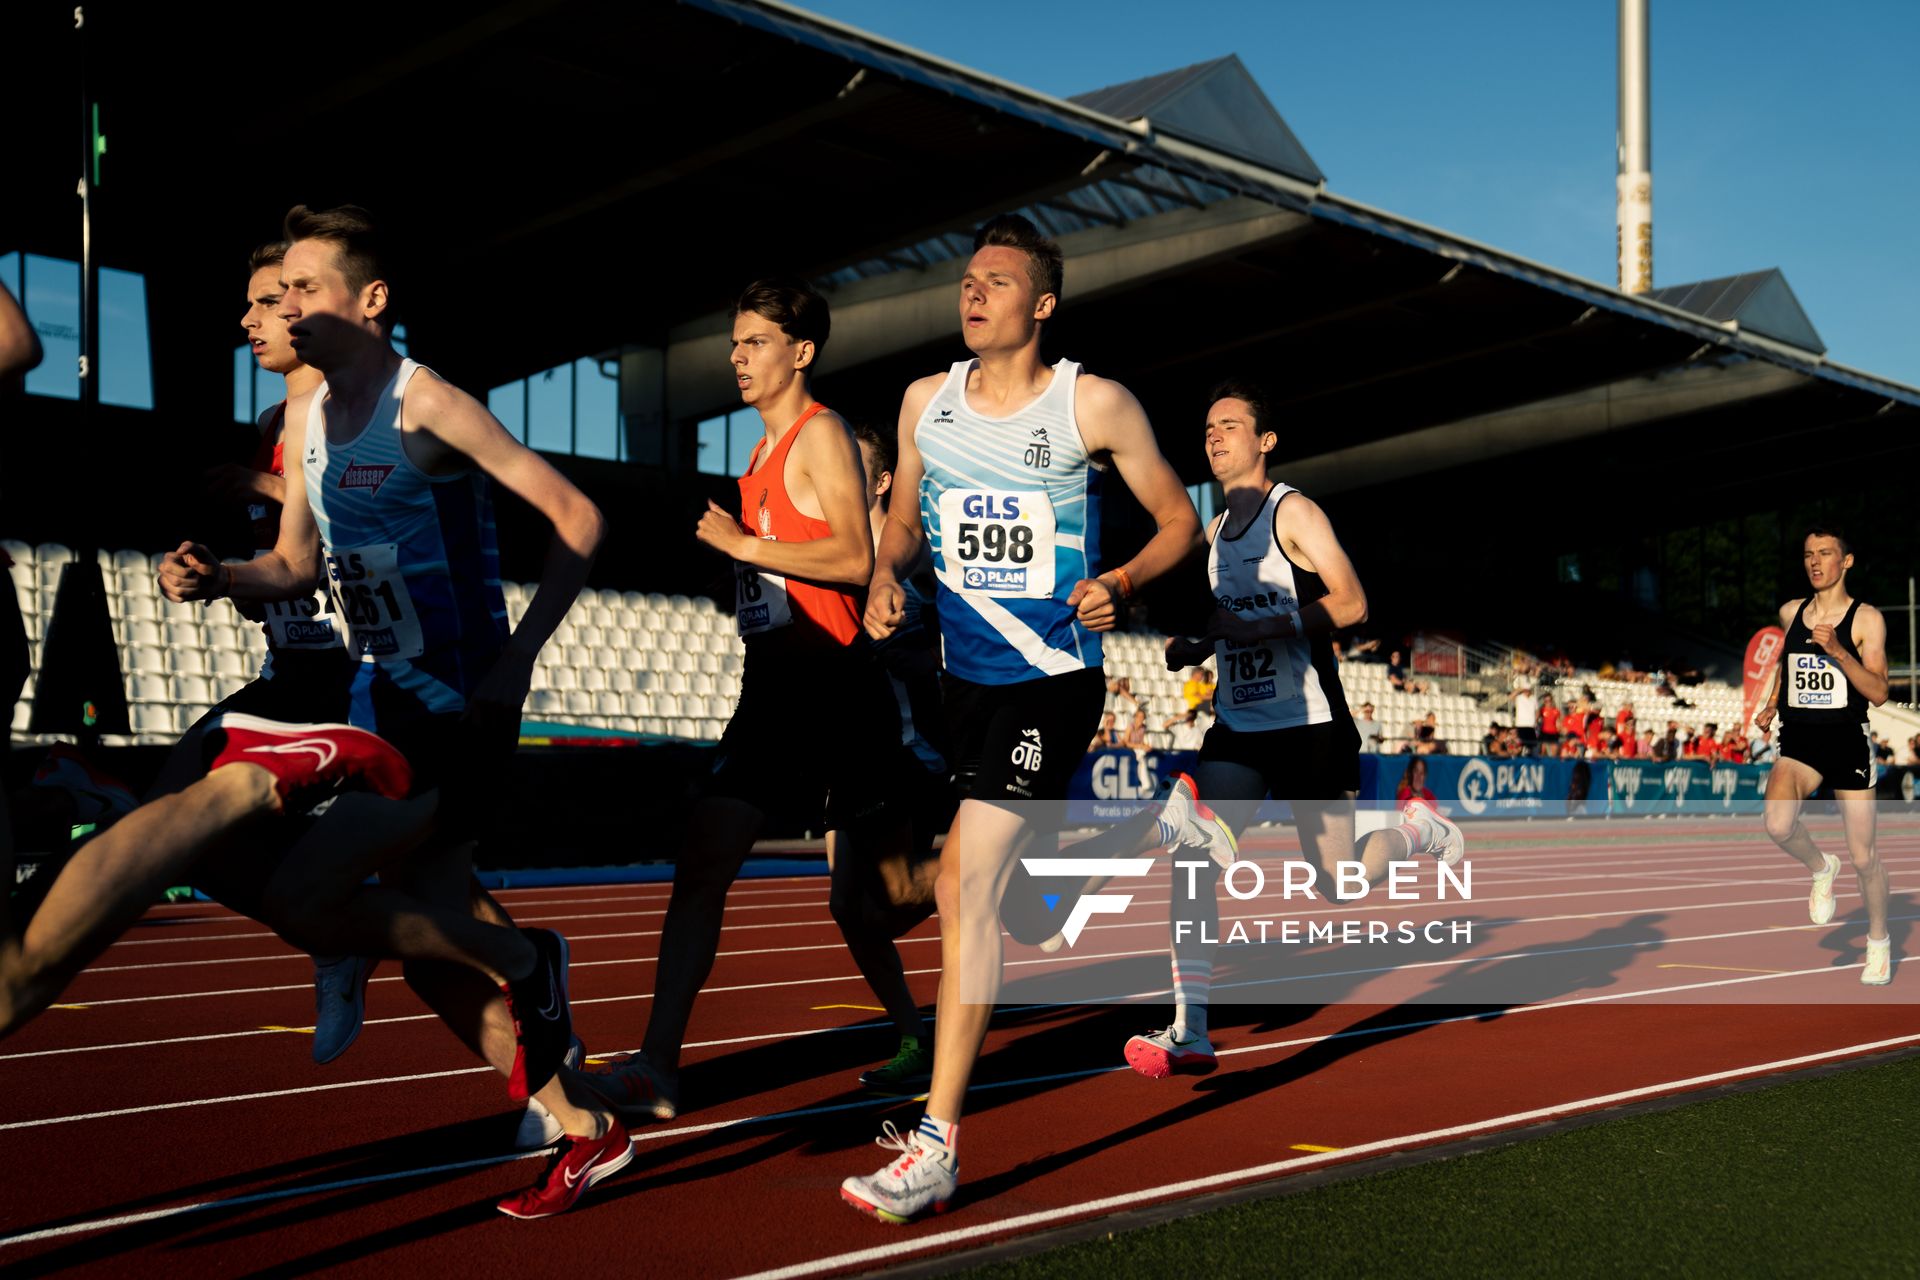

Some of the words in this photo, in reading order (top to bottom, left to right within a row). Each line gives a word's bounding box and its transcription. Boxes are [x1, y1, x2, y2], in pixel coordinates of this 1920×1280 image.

[74, 6, 84, 29] 5
[79, 355, 89, 378] 3
[1024, 443, 1051, 468] OTB
[963, 494, 1020, 520] GLS
[957, 523, 1034, 563] 598
[327, 554, 365, 581] GLS
[987, 571, 1024, 583] PLAN
[332, 580, 402, 625] 1261
[748, 608, 768, 620] PLAN
[302, 623, 331, 635] PLAN
[1224, 648, 1277, 682] 782
[1797, 657, 1826, 669] GLS
[1247, 683, 1273, 695] PLAN
[1795, 671, 1834, 690] 580
[1011, 740, 1042, 772] OTB
[1091, 754, 1159, 800] GLS
[1496, 764, 1545, 793] PLAN
[1006, 783, 1033, 798] erima
[1093, 805, 1121, 817] Parcels
[1122, 807, 1131, 816] to
